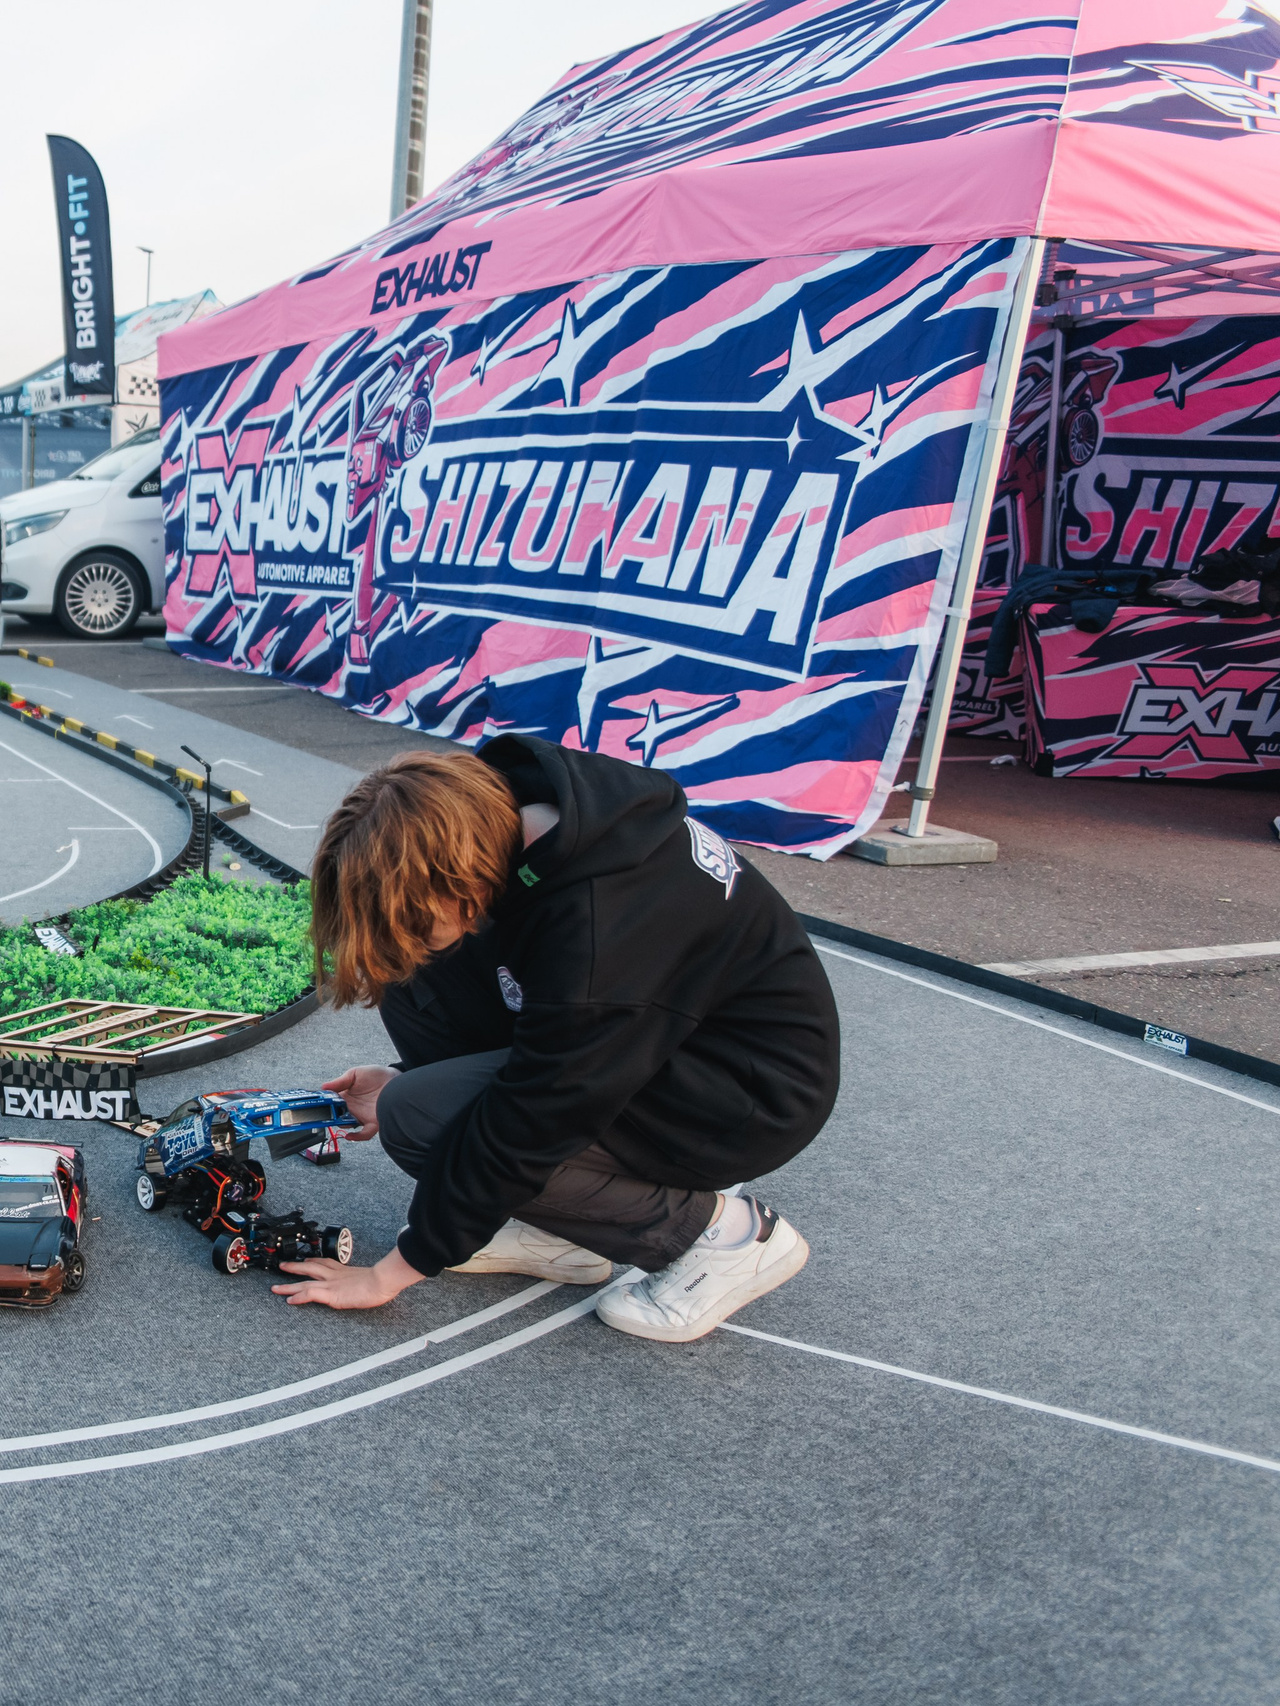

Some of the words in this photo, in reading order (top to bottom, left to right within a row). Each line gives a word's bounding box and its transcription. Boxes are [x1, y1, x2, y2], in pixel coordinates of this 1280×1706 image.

[370, 240, 493, 315] EXHAUST
[186, 459, 348, 554] EXHAUST
[258, 562, 305, 583] AUTOMOTIVE
[306, 564, 351, 586] APPAREL
[1147, 1026, 1186, 1045] EXHAUST
[3, 1086, 131, 1120] EXHAUST
[684, 1272, 708, 1293] Reebok
